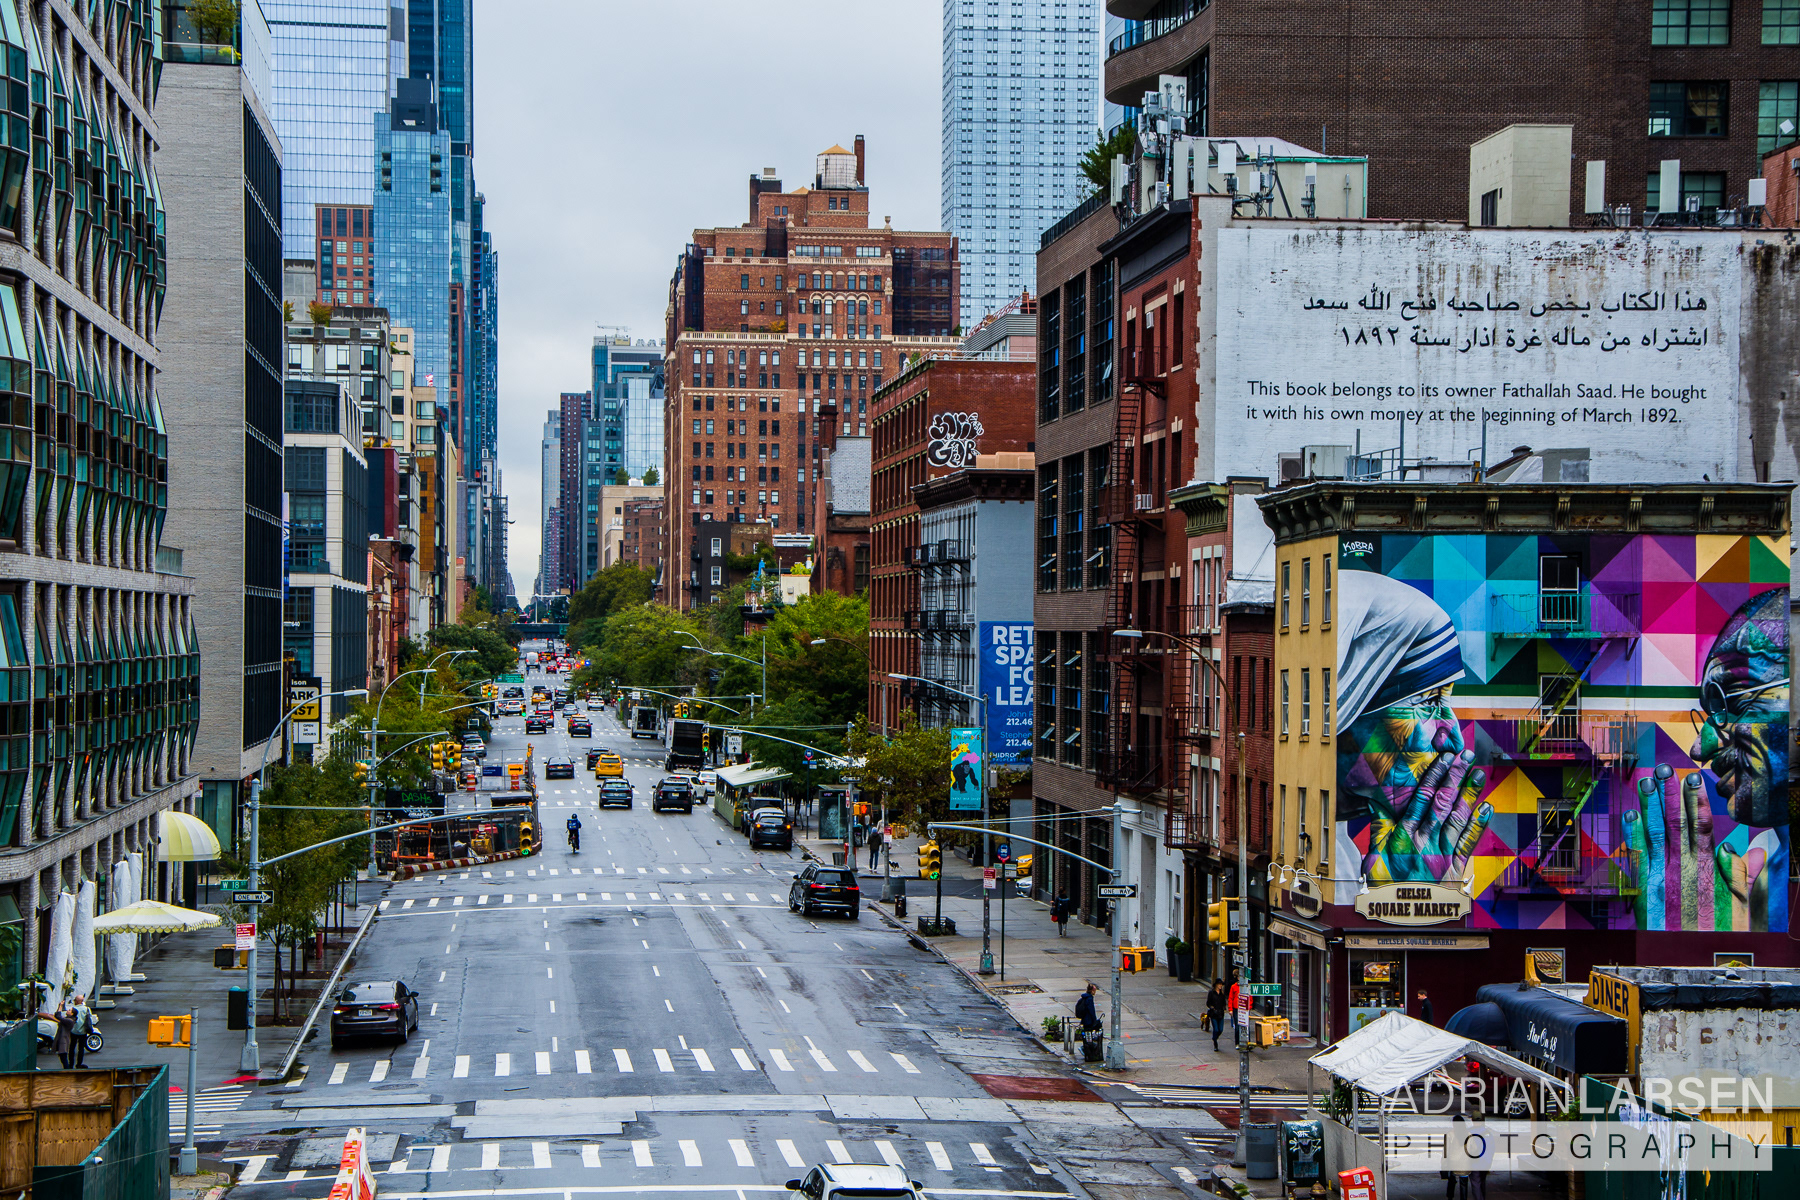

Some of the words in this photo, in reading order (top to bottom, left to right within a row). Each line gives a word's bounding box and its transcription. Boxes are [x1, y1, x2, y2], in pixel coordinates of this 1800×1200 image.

[1303, 297, 1349, 310] سعد
[1401, 292, 1437, 321] فتح
[1447, 292, 1520, 318] صاحبه
[1530, 294, 1591, 318] يخص
[1601, 290, 1666, 319] الكتاب
[1675, 291, 1708, 312] هذا
[1342, 327, 1399, 346] ١٨٩٢
[1410, 326, 1451, 346] سنة
[1458, 328, 1497, 353] اذار
[1506, 328, 1543, 353] غرة
[1551, 326, 1591, 346] ماله
[1601, 331, 1631, 351] من
[1247, 381, 1280, 396] This
[1286, 382, 1327, 396] book
[1332, 382, 1392, 400] belongs
[1398, 385, 1415, 397] to
[1421, 384, 1439, 397] its
[1445, 387, 1496, 397] owner
[1502, 383, 1571, 398] Fathallah
[1577, 384, 1617, 398] Saad.
[1622, 384, 1645, 398] He
[1651, 385, 1707, 403] bought
[1247, 406, 1258, 420] it
[1262, 405, 1297, 420] with
[1303, 406, 1324, 420] his
[1331, 410, 1364, 421] own
[1371, 410, 1424, 425] money
[1429, 409, 1445, 421] at
[1450, 407, 1476, 421] the
[1482, 407, 1556, 426] beginning
[1561, 408, 1578, 421] of
[1583, 408, 1632, 422] March
[1641, 408, 1682, 423] 1892.
[1342, 541, 1374, 552] KOBRA
[992, 625, 1034, 645] RET
[290, 691, 315, 701] ARK
[290, 706, 315, 716] AST
[1396, 888, 1432, 900] CHELSEA
[1368, 902, 1411, 917] SQUARE
[1414, 902, 1461, 917] MARKET
[1431, 938, 1458, 946] MARKET
[1252, 985, 1259, 994] W
[1262, 985, 1270, 994] 18
[1592, 976, 1630, 1017] DINER
